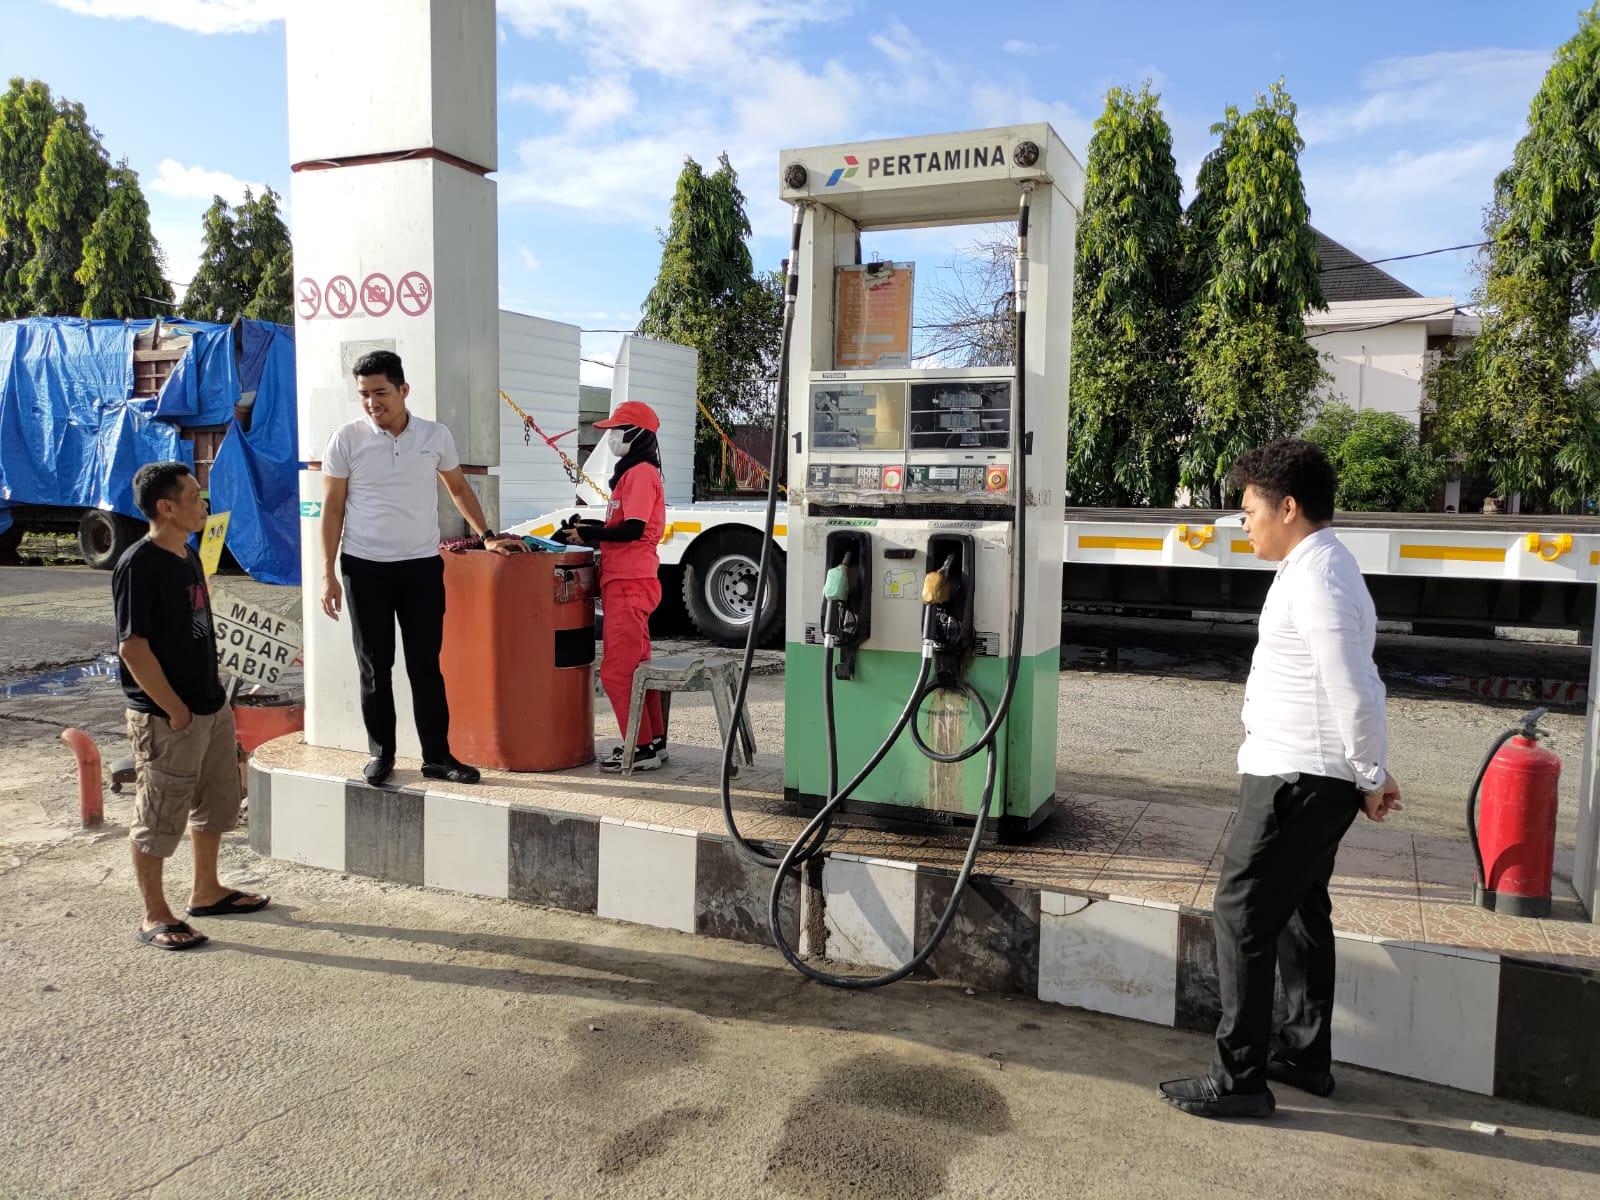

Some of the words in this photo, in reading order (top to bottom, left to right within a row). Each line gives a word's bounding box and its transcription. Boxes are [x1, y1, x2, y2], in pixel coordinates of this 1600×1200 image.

[867, 145, 1006, 178] PERTAMINA
[791, 431, 802, 454] 1
[230, 603, 286, 636] MAAF
[215, 622, 289, 665] SOLAR
